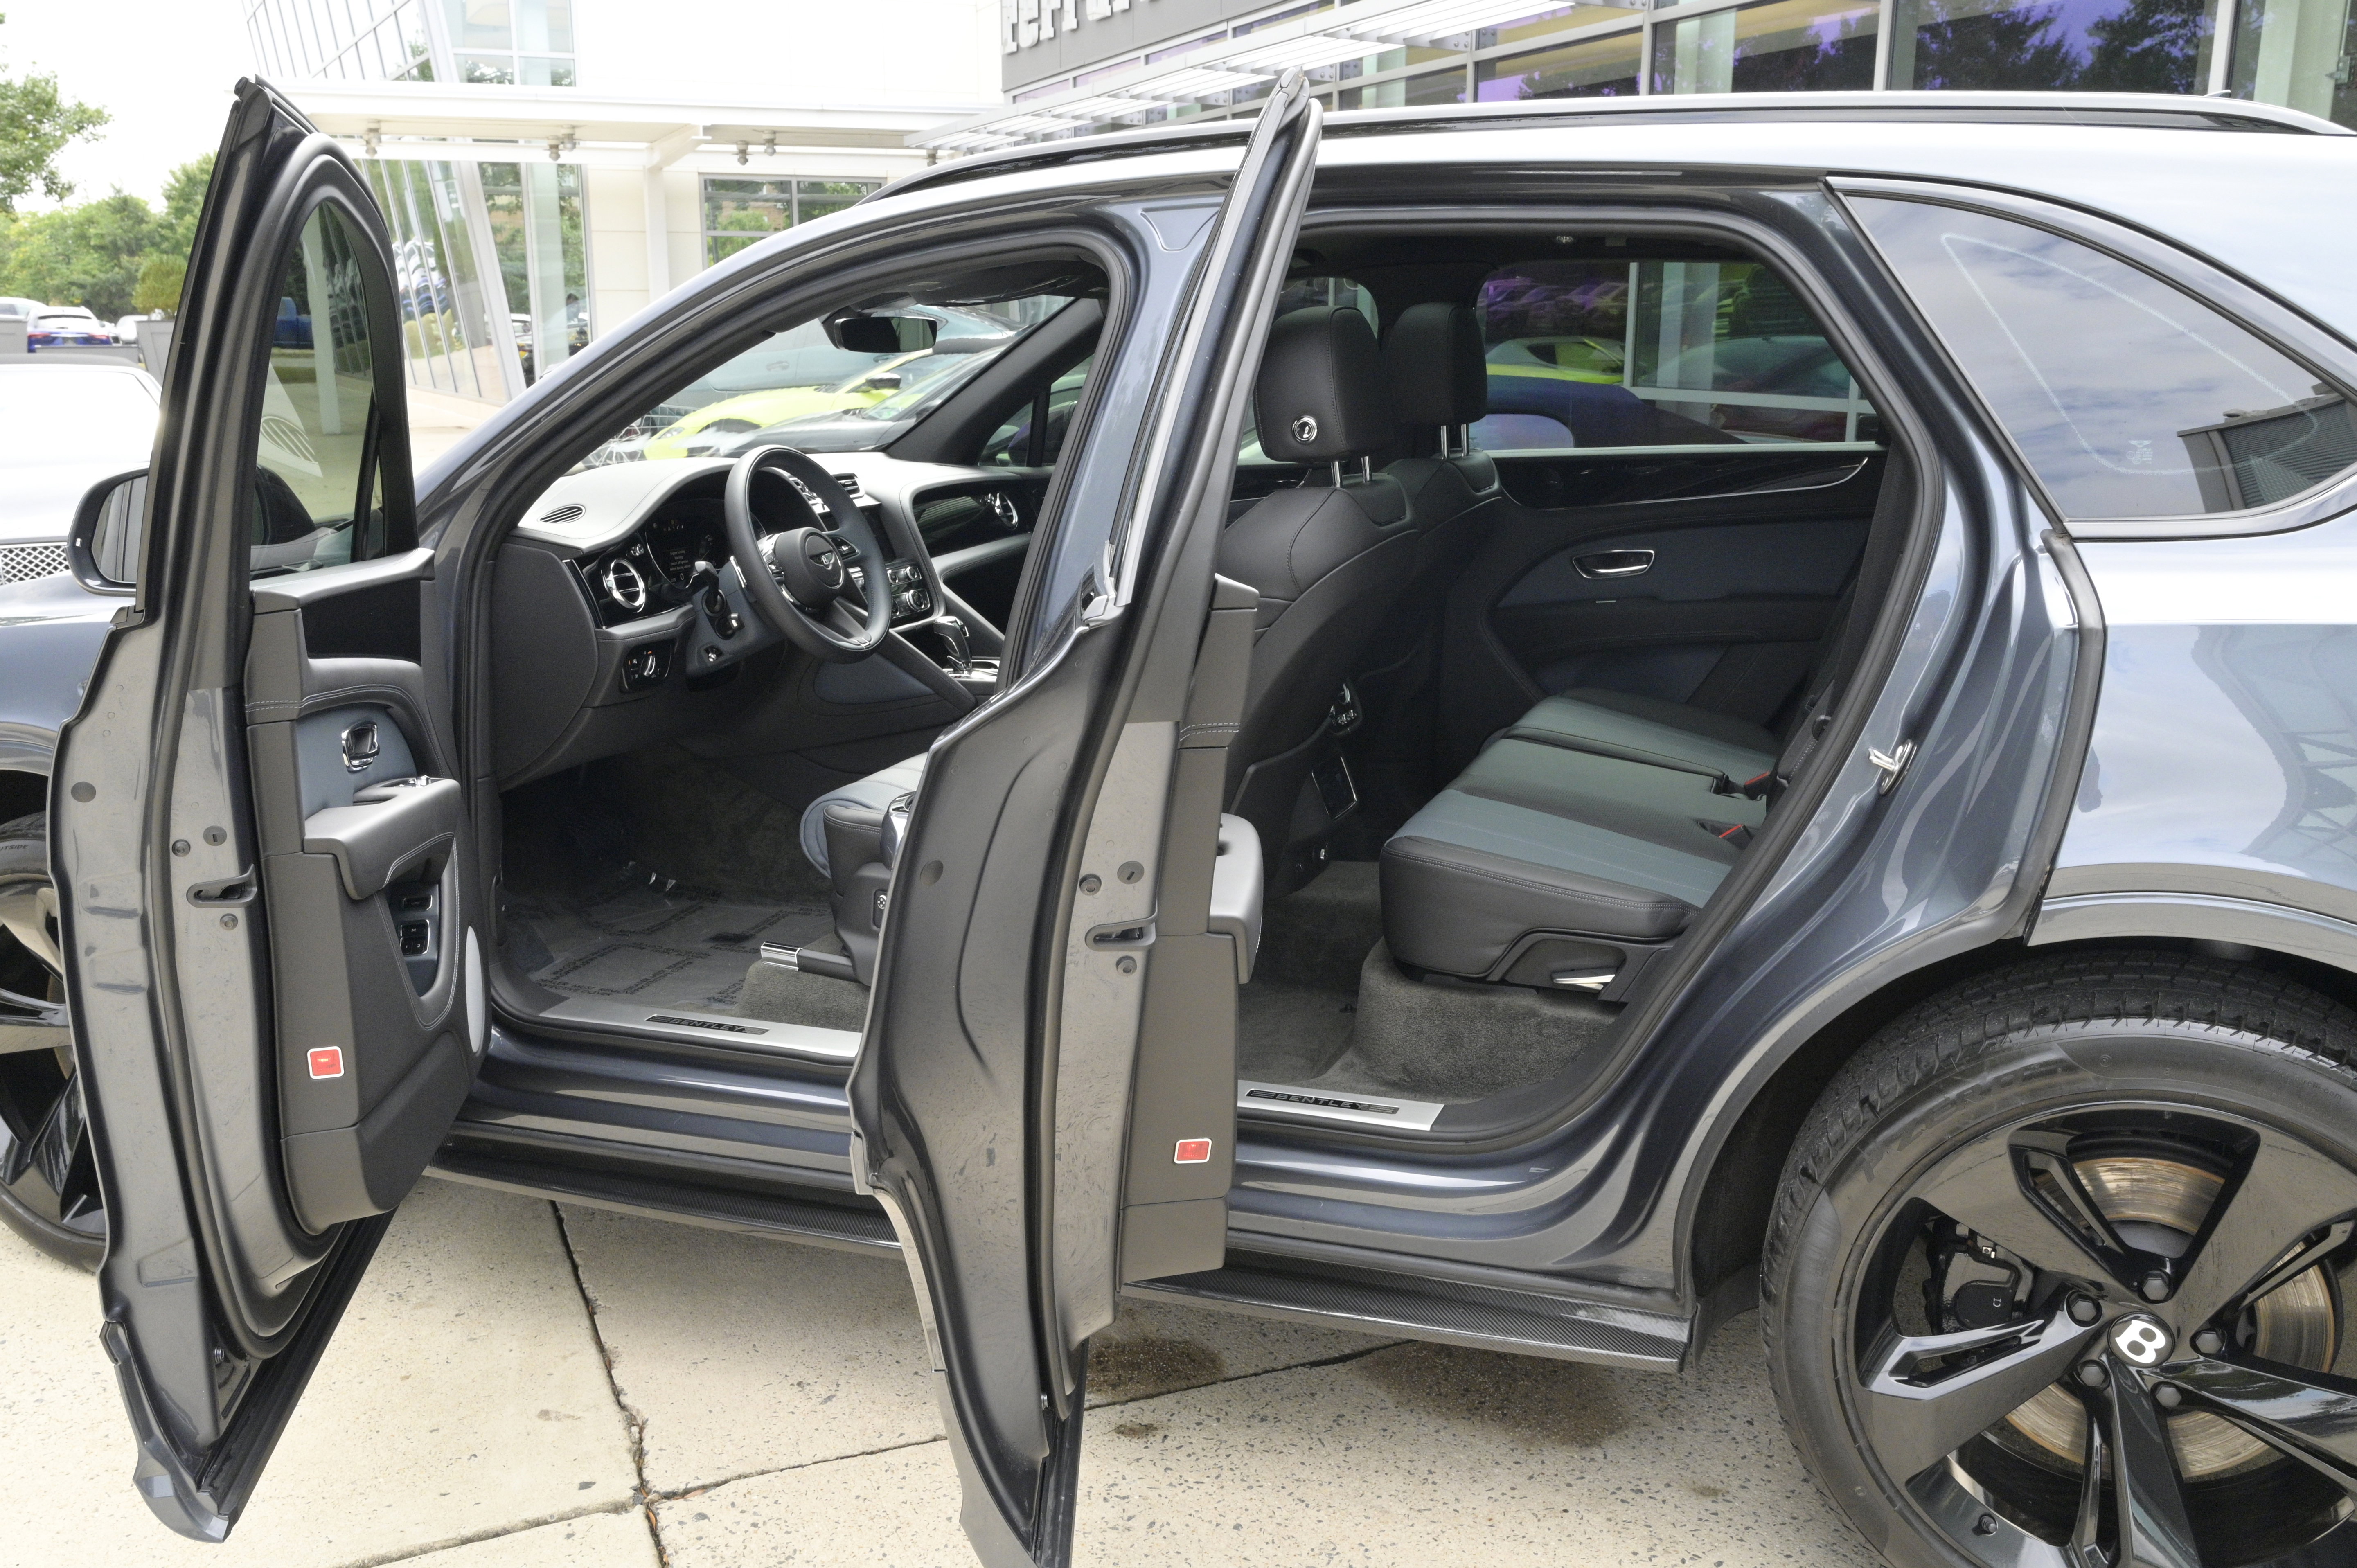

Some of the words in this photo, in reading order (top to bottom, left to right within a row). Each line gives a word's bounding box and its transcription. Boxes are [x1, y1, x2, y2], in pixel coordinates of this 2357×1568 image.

[671, 1018, 746, 1032] BENTLEY
[1275, 1093, 1369, 1110] BENTLEY
[2115, 1319, 2166, 1364] B
